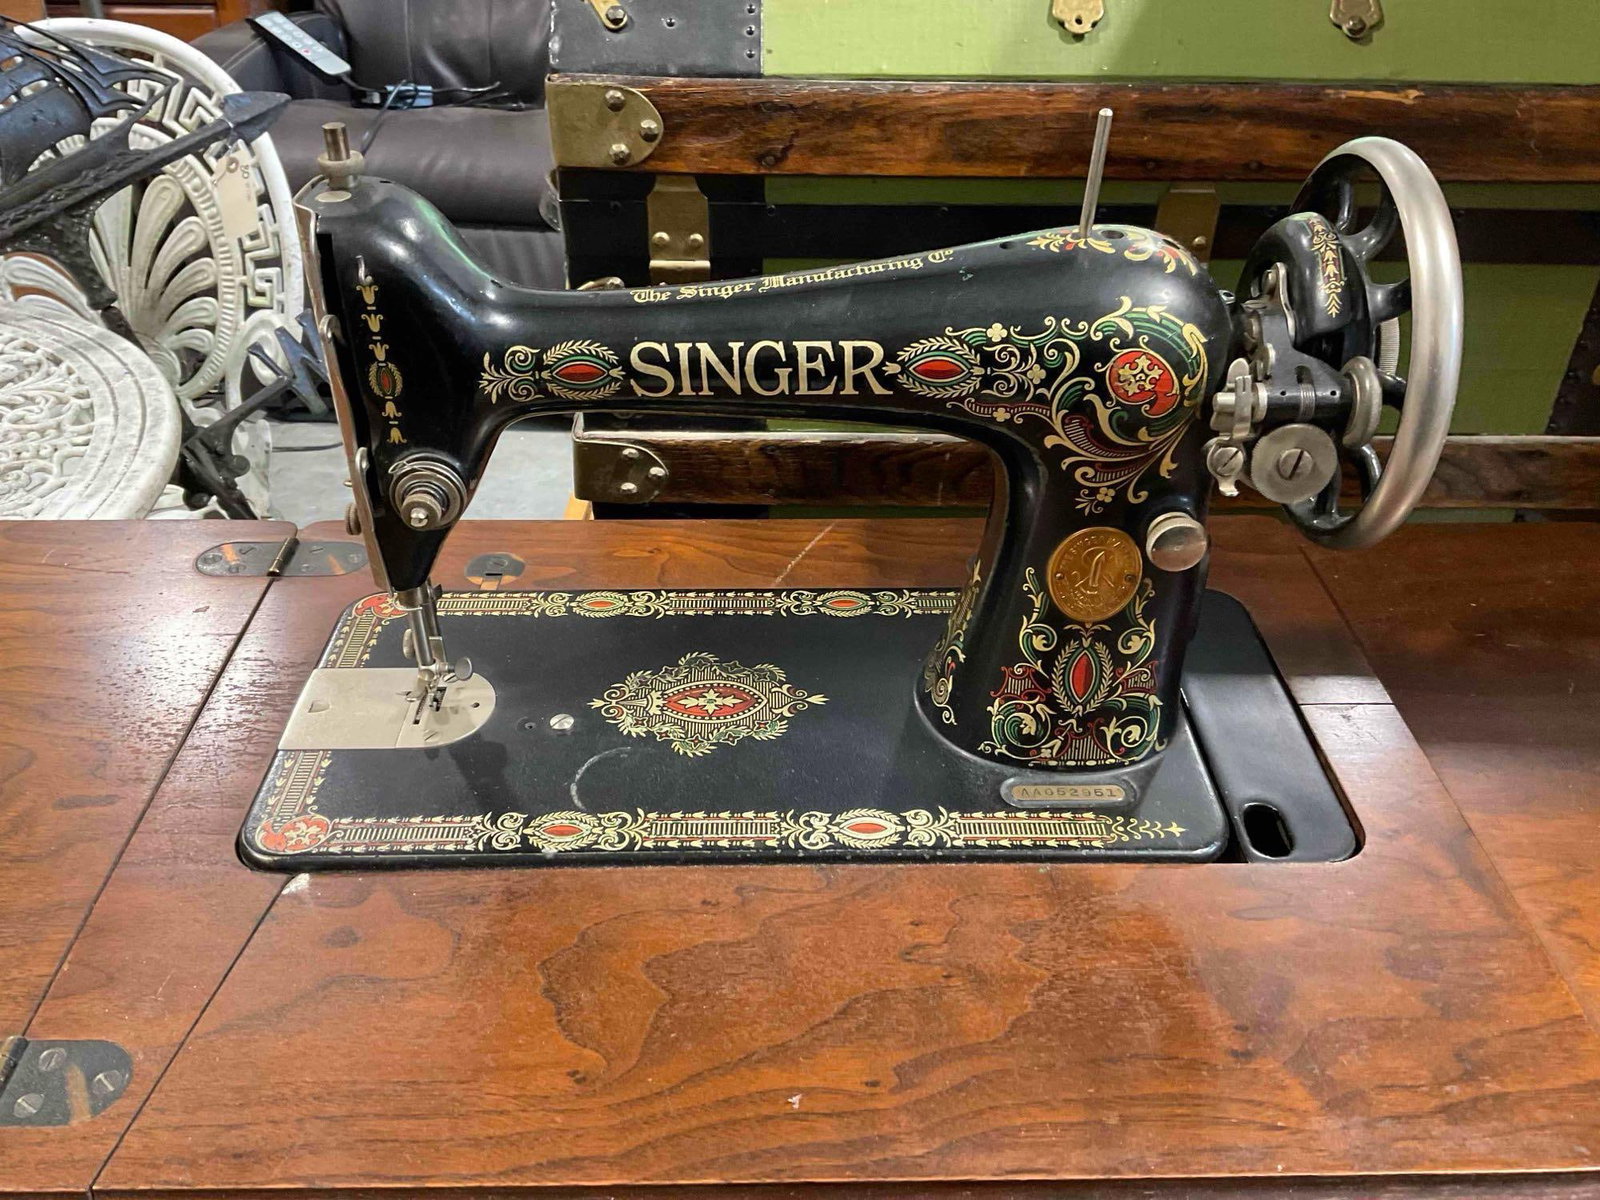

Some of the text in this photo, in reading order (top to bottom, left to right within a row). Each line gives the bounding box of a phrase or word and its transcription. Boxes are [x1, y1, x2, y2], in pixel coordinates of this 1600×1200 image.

[630, 289, 671, 303] The
[676, 281, 756, 299] Singer
[758, 256, 923, 293] Manufacturing
[629, 340, 894, 397] SINGER
